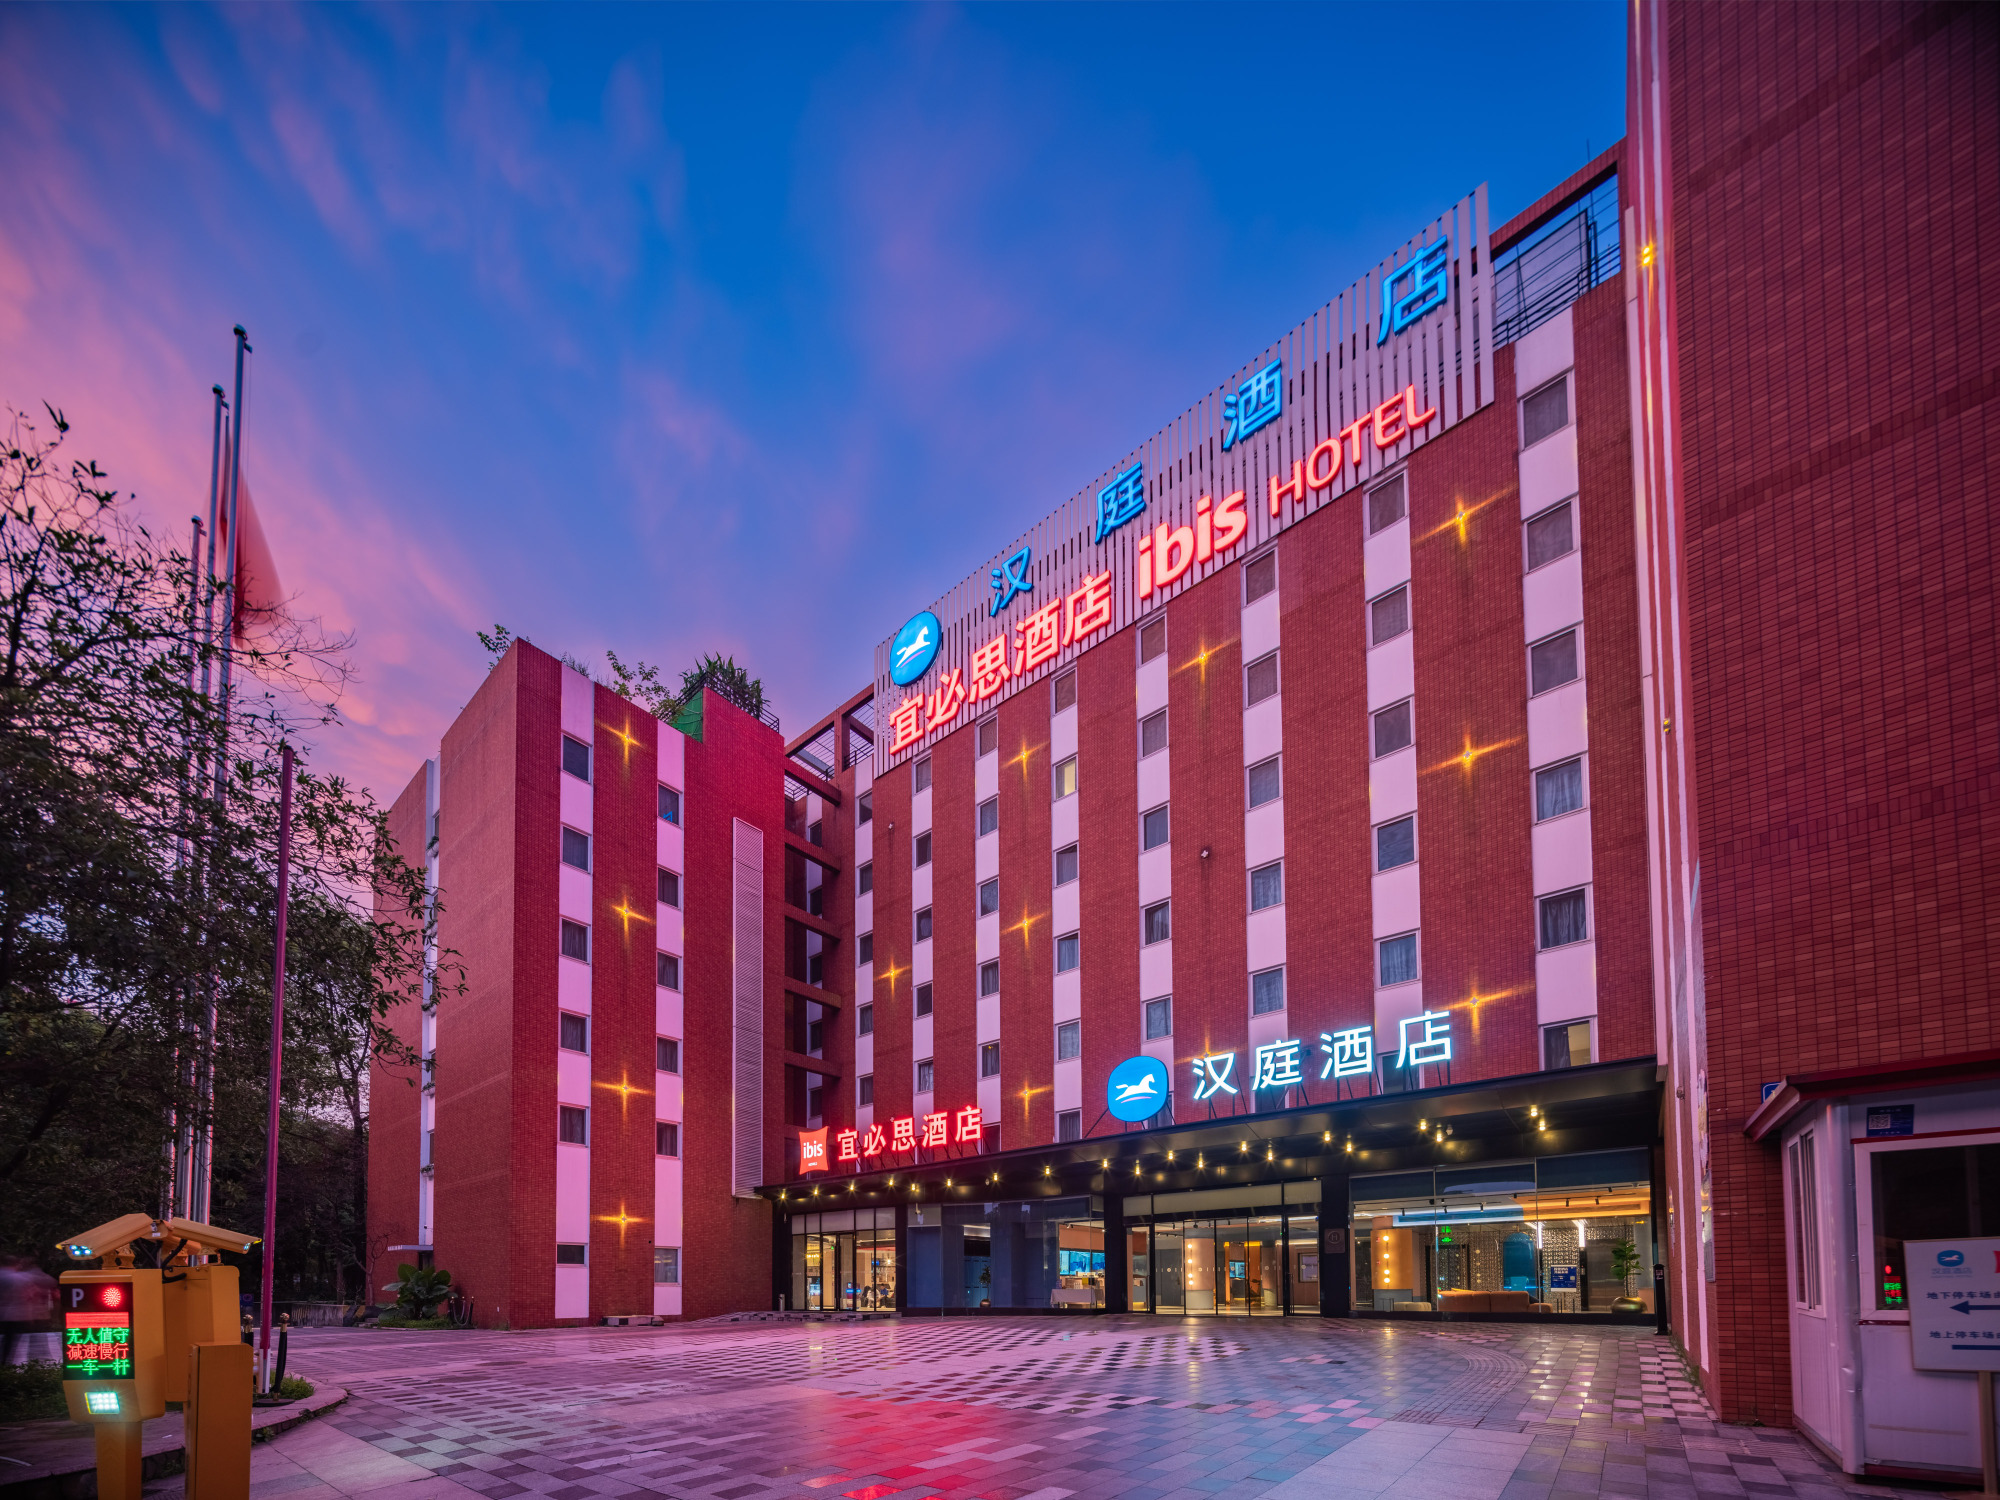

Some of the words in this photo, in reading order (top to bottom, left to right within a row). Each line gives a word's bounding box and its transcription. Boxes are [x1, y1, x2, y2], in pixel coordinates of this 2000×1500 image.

[989, 235, 1449, 617] 汉庭酒店
[889, 569, 1112, 755] 宜必思酒店
[1138, 489, 1247, 600] ibis
[1270, 384, 1436, 518] HOTEL
[1192, 1011, 1452, 1100] 汉庭酒店
[837, 1105, 983, 1161] 宜必思酒店
[803, 1140, 823, 1159] ibis
[72, 1288, 84, 1308] P
[66, 1327, 130, 1344] 无人值守
[66, 1343, 129, 1360] 减速慢行
[66, 1359, 130, 1376] 一车一杆
